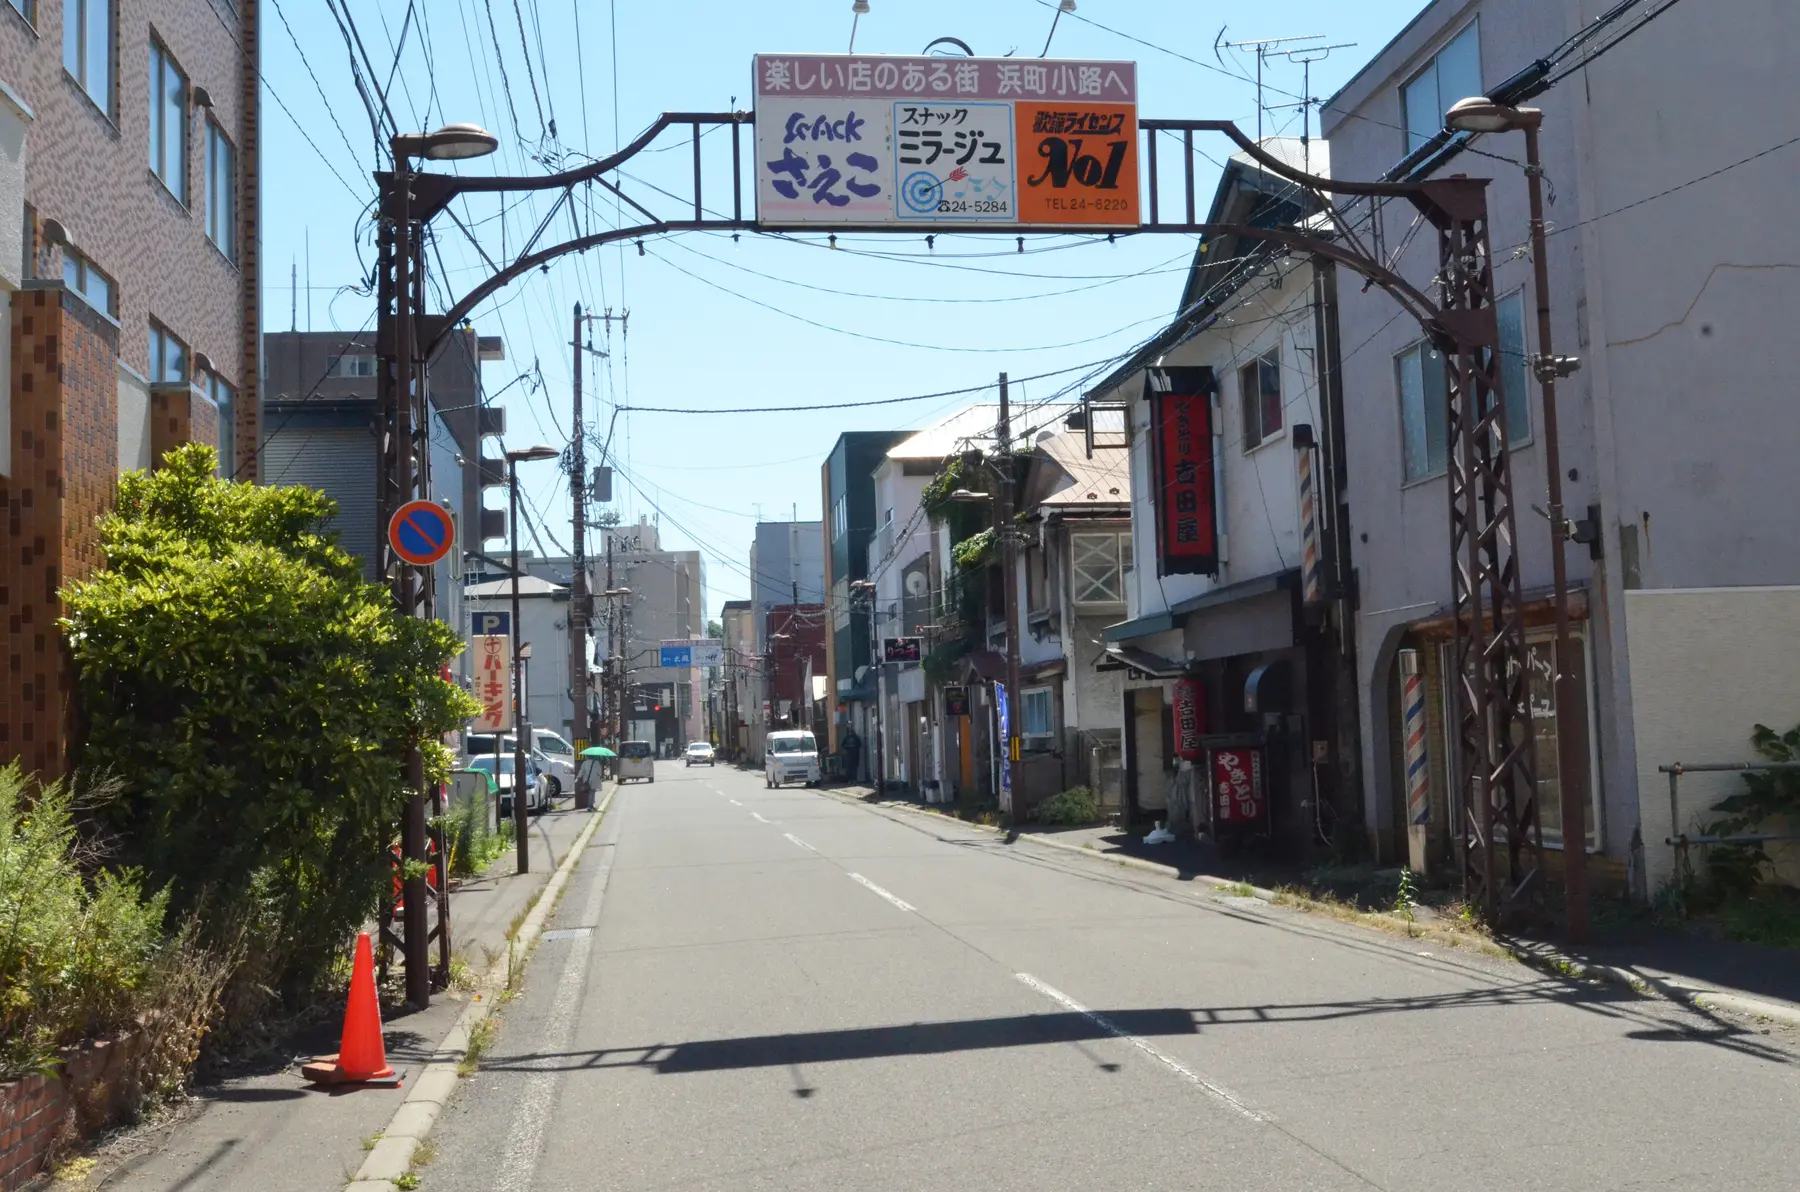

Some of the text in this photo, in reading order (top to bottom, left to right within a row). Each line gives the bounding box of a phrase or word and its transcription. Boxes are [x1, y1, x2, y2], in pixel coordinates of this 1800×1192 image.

[765, 60, 1128, 95] 楽しい店のある街 浜町小路へ
[901, 107, 968, 126] スナック
[898, 130, 1005, 165] ミラージュ
[766, 146, 881, 206] さえこ
[482, 615, 501, 635] P
